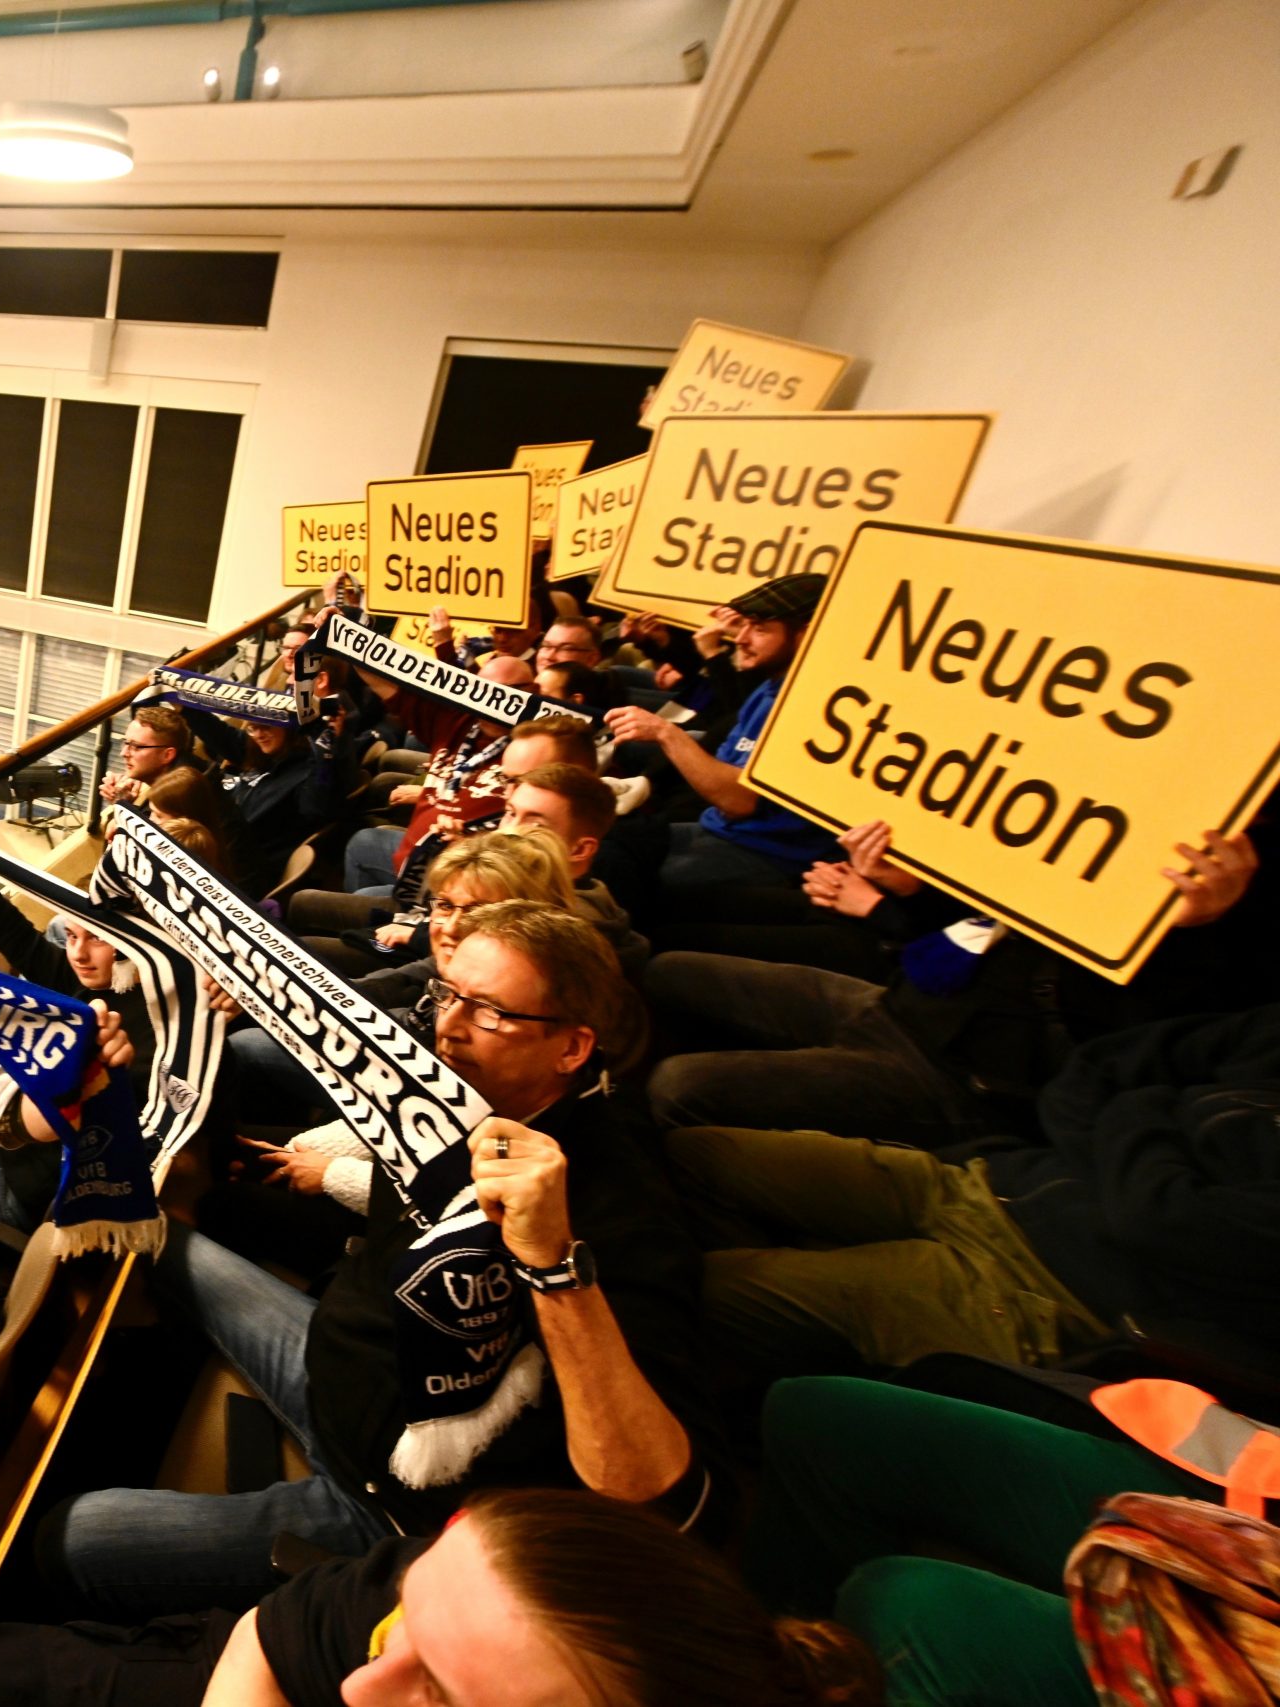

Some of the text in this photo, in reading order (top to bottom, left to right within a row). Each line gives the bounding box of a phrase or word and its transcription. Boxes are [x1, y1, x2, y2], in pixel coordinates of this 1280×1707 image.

[696, 345, 803, 401] Neues
[685, 447, 902, 512] Neues
[300, 518, 367, 543] Neues
[391, 502, 499, 543] Neues
[652, 516, 842, 580] Stadio
[384, 553, 505, 599] Stadion
[332, 618, 369, 654] VfB
[368, 641, 524, 718] OLDENBURG
[864, 578, 1195, 740] Neues
[803, 684, 1130, 882] Stadion
[155, 839, 357, 1010] Mit dem Geist von Donnerschwee
[442, 1262, 513, 1311] VfB
